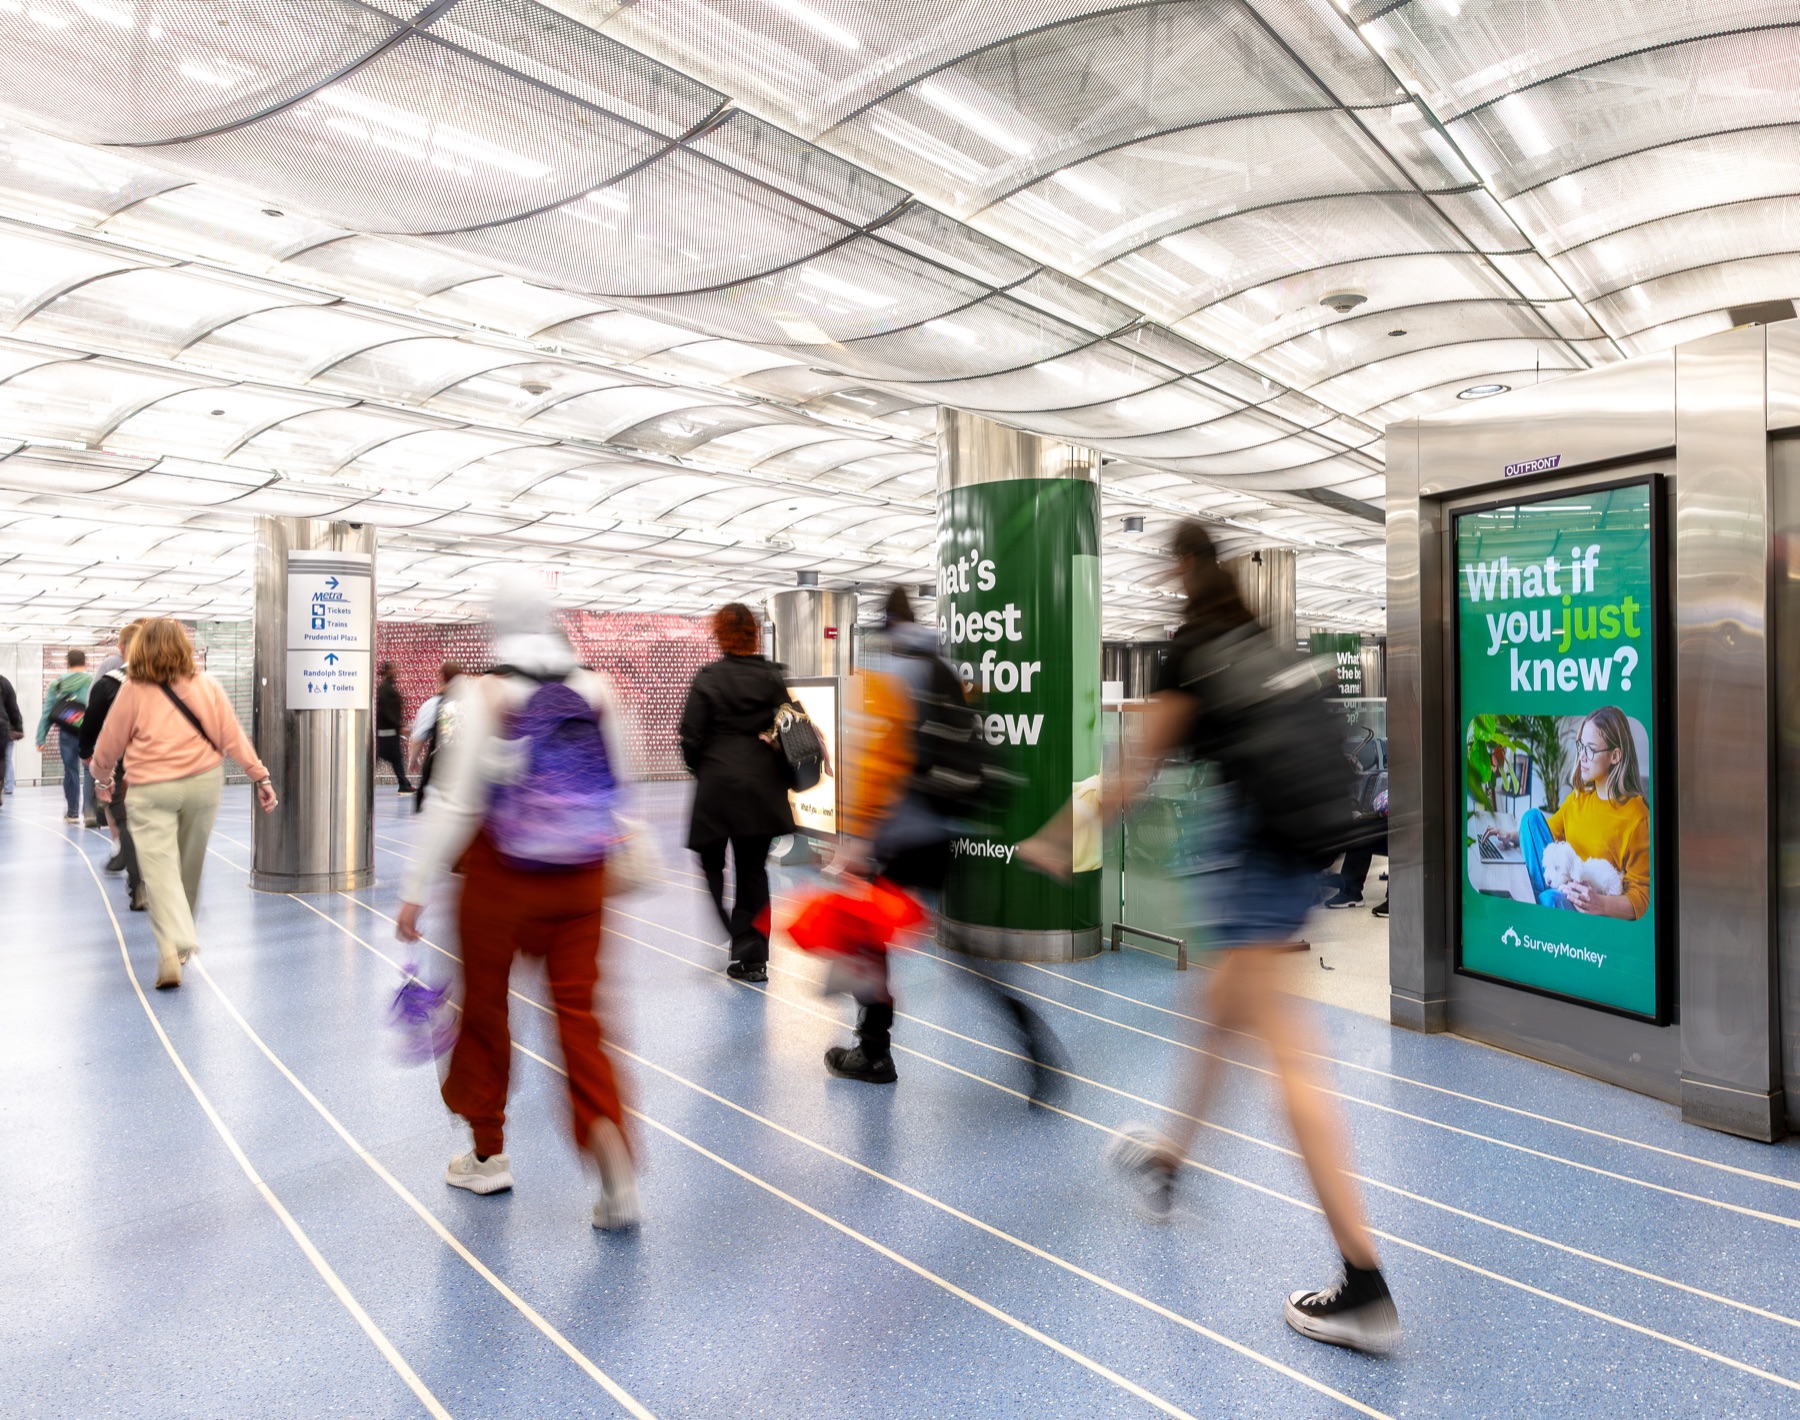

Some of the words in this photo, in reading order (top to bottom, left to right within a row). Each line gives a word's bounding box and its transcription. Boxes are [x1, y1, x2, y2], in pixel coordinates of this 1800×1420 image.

[1506, 457, 1557, 477] OUTFRONT
[937, 549, 996, 596] hat's
[1466, 556, 1562, 602] What
[1571, 544, 1601, 594] if
[312, 592, 343, 602] Metra
[951, 602, 1022, 644] best
[1486, 609, 1551, 656] you
[1558, 594, 1641, 653] just
[980, 649, 1041, 693] for
[1510, 646, 1639, 692] knew?
[949, 837, 1015, 864] eyMonkey
[1523, 934, 1605, 968] SurveyMonkey
